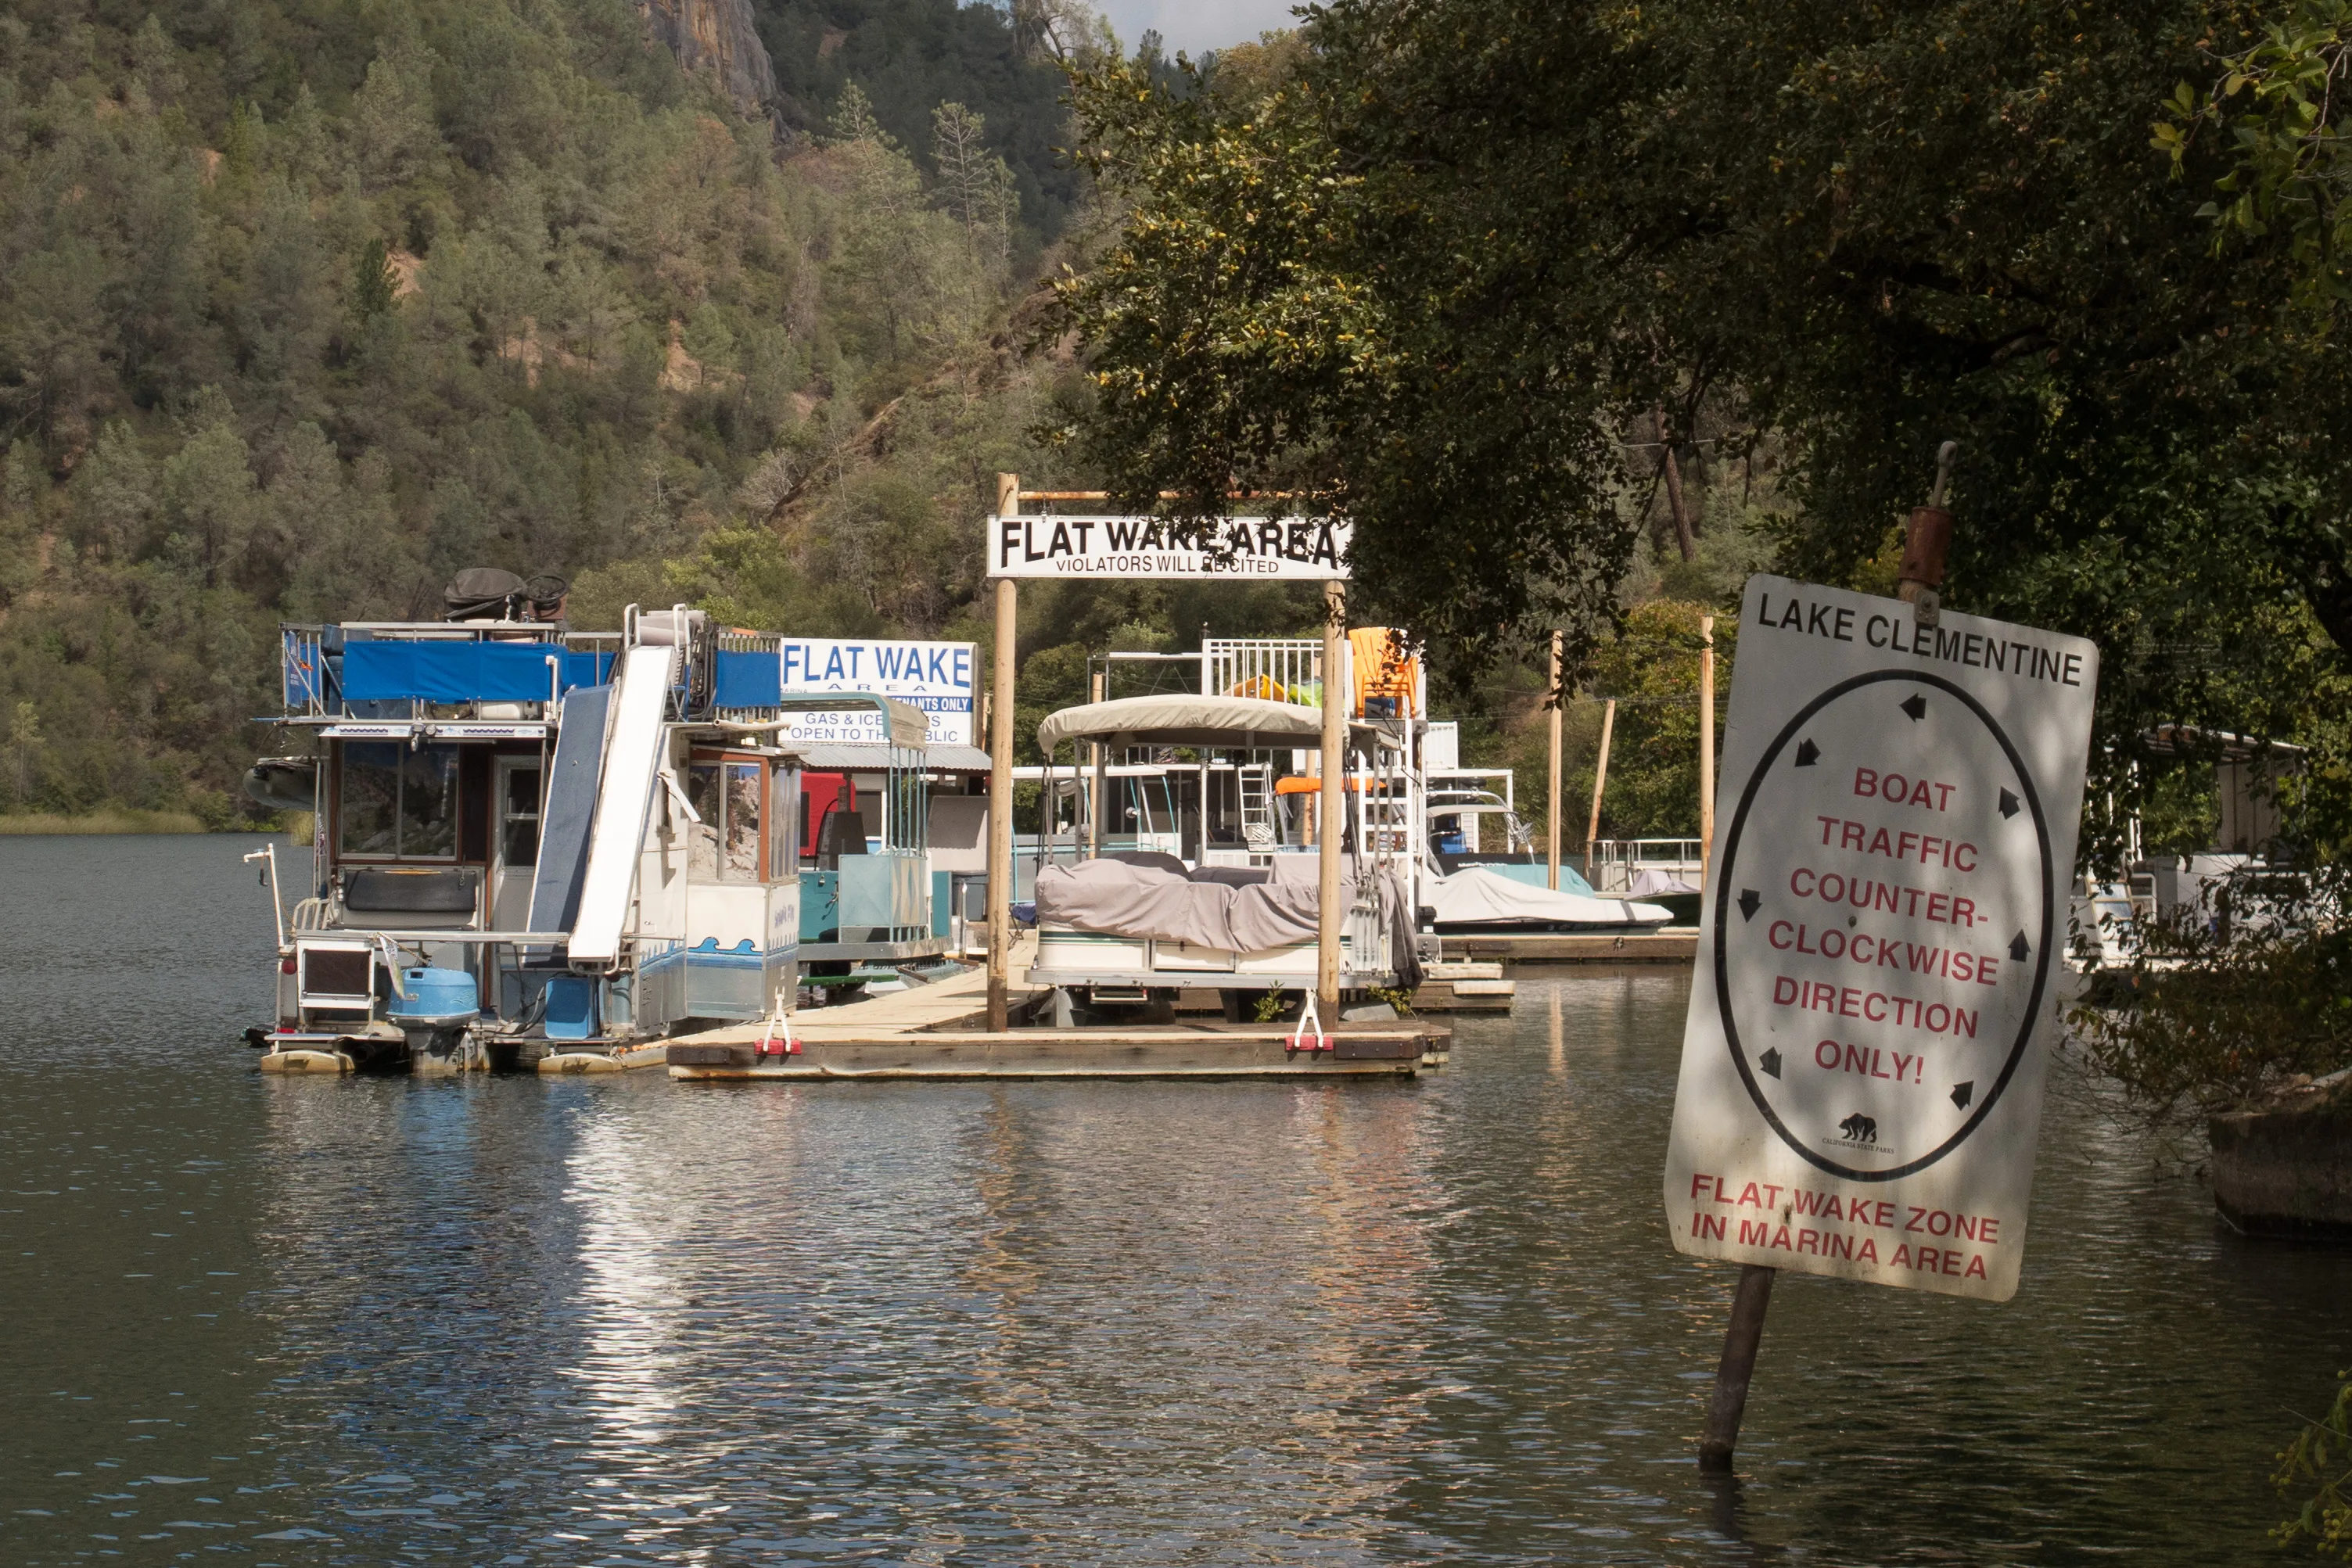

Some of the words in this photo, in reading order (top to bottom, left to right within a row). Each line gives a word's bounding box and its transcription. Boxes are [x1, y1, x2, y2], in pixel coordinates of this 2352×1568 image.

[1000, 522, 1094, 569] FLAT
[1232, 522, 1338, 570] AREA
[1056, 556, 1152, 572] VIOLATORS
[1156, 556, 1195, 572] WILL
[1229, 558, 1279, 573] CITED
[1758, 593, 1856, 642] LAKE
[1865, 614, 2083, 687] CLEMENTINE
[783, 644, 864, 684] FLAT
[874, 647, 970, 688] WAKE
[828, 683, 927, 692] AREA
[805, 712, 838, 725] GAS
[844, 714, 856, 725] &
[860, 714, 883, 725] ICE
[941, 698, 969, 711] ONLY
[791, 727, 835, 739] OPEN
[842, 729, 862, 740] TO
[925, 730, 958, 741] BLIC
[1853, 766, 1956, 813] BOAT
[1817, 815, 1978, 873] TRAFFIC
[1790, 867, 1988, 928] COUNTER-
[1768, 920, 2000, 986] CLOCKWISE
[1772, 975, 1978, 1039] DIRECTION
[1815, 1039, 1924, 1085] ONLY!
[1822, 1137, 1856, 1149] CALIFORNIA
[1857, 1143, 1875, 1152] STATE
[1690, 1173, 1785, 1210] FLAT
[1794, 1188, 1896, 1229] WAKE
[1905, 1206, 2000, 1244] ZONE
[1691, 1211, 1727, 1242] IN
[1738, 1219, 1879, 1265] MARINA
[1890, 1243, 1988, 1281] AREA
